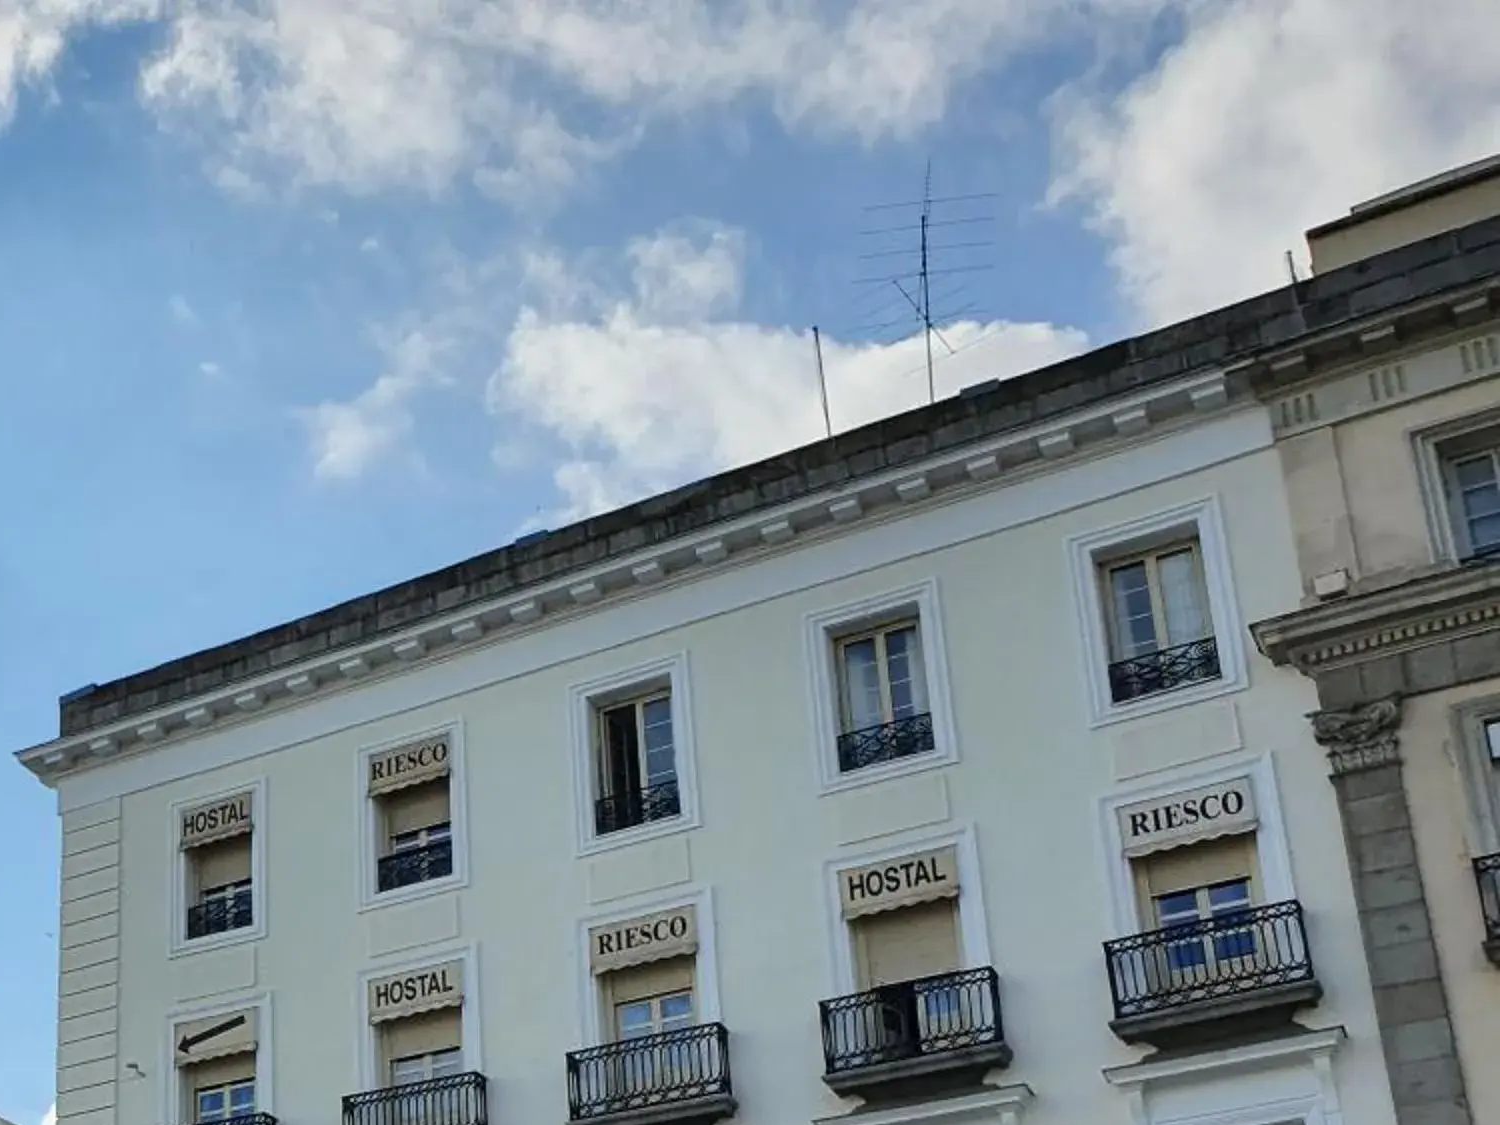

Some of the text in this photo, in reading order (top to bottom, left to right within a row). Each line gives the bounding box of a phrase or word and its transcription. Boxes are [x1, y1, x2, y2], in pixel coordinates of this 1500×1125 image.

[371, 742, 449, 782] RIESCO
[182, 803, 250, 837] HOSTAL
[1129, 789, 1244, 837] RIESCO
[848, 856, 947, 900] HOSTAL
[597, 914, 688, 957] RIESCO
[374, 968, 454, 1007] HOSTAL
